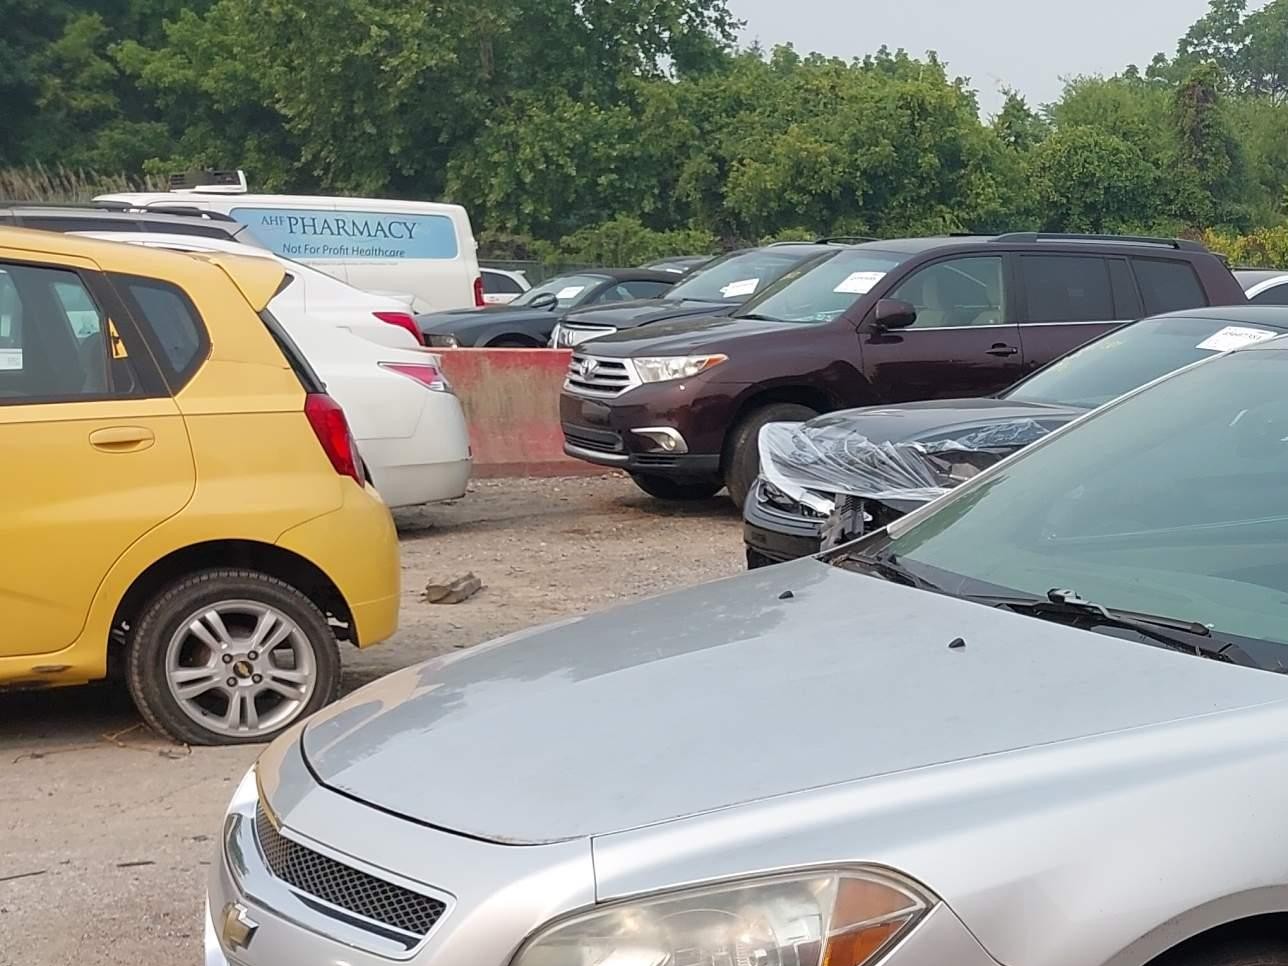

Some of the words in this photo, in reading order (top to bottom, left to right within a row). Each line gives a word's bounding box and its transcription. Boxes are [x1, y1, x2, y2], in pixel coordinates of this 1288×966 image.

[261, 216, 286, 226] AHF
[288, 216, 416, 239] PHARMACY
[282, 242, 302, 254] Not
[304, 245, 320, 255] For
[322, 245, 349, 257] Profit
[351, 246, 405, 258] Healthcare
